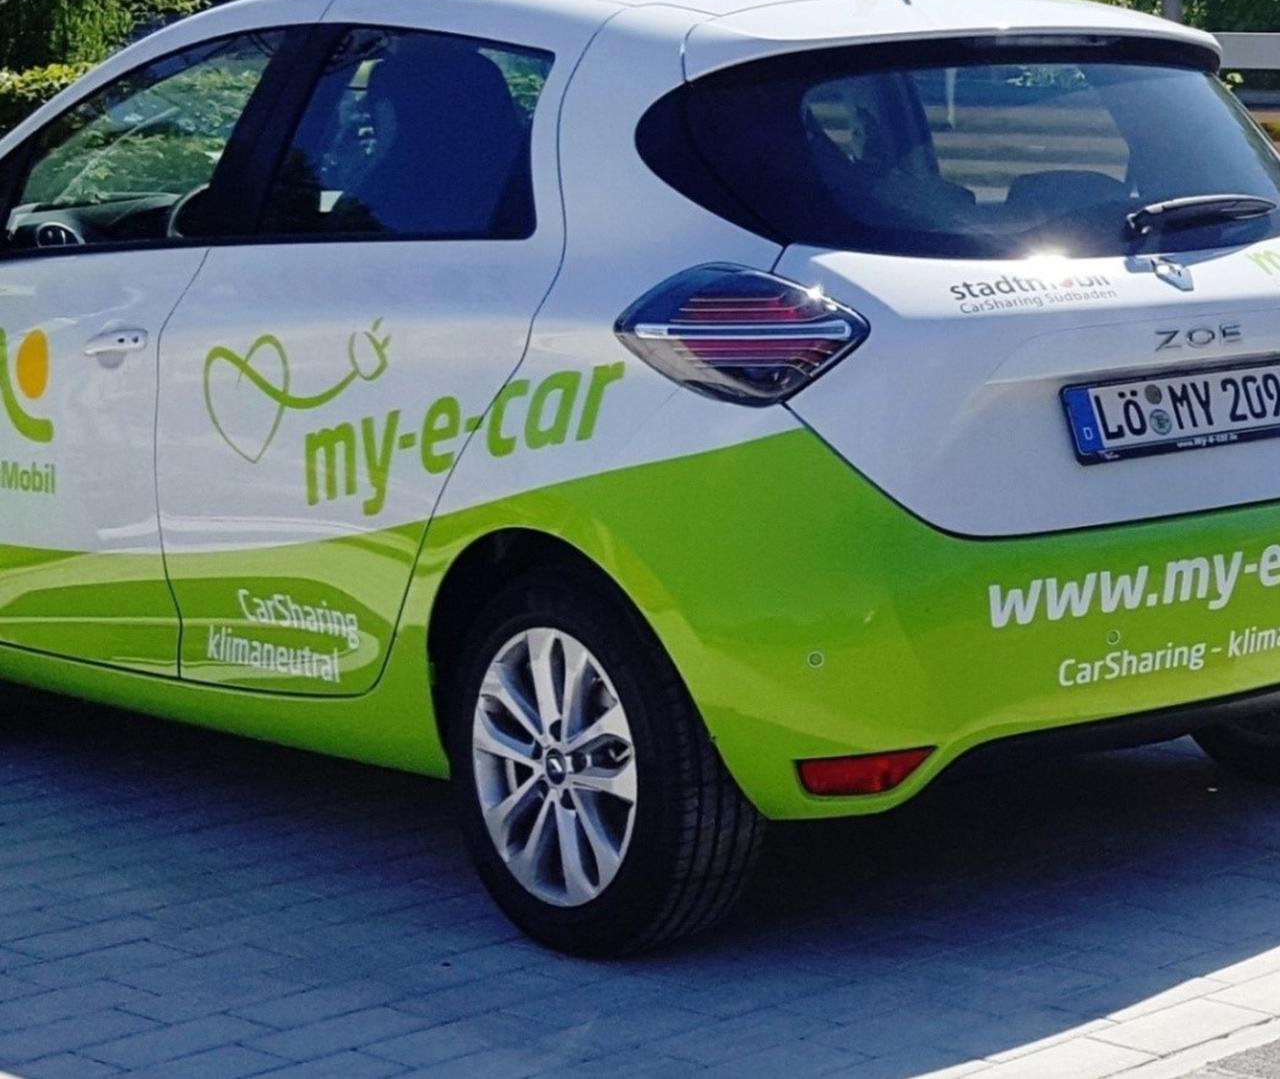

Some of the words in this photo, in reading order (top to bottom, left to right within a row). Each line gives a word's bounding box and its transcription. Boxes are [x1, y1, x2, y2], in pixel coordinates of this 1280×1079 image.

[959, 294, 1044, 315] CarSharing
[1154, 324, 1243, 352] ZOE
[304, 361, 626, 517] my-e-car
[1094, 390, 1148, 441] LÖ
[1167, 381, 1215, 430] MY
[237, 588, 361, 650] CarSharing
[207, 624, 341, 684] klimaneutral
[1057, 641, 1206, 688] CarSharing
